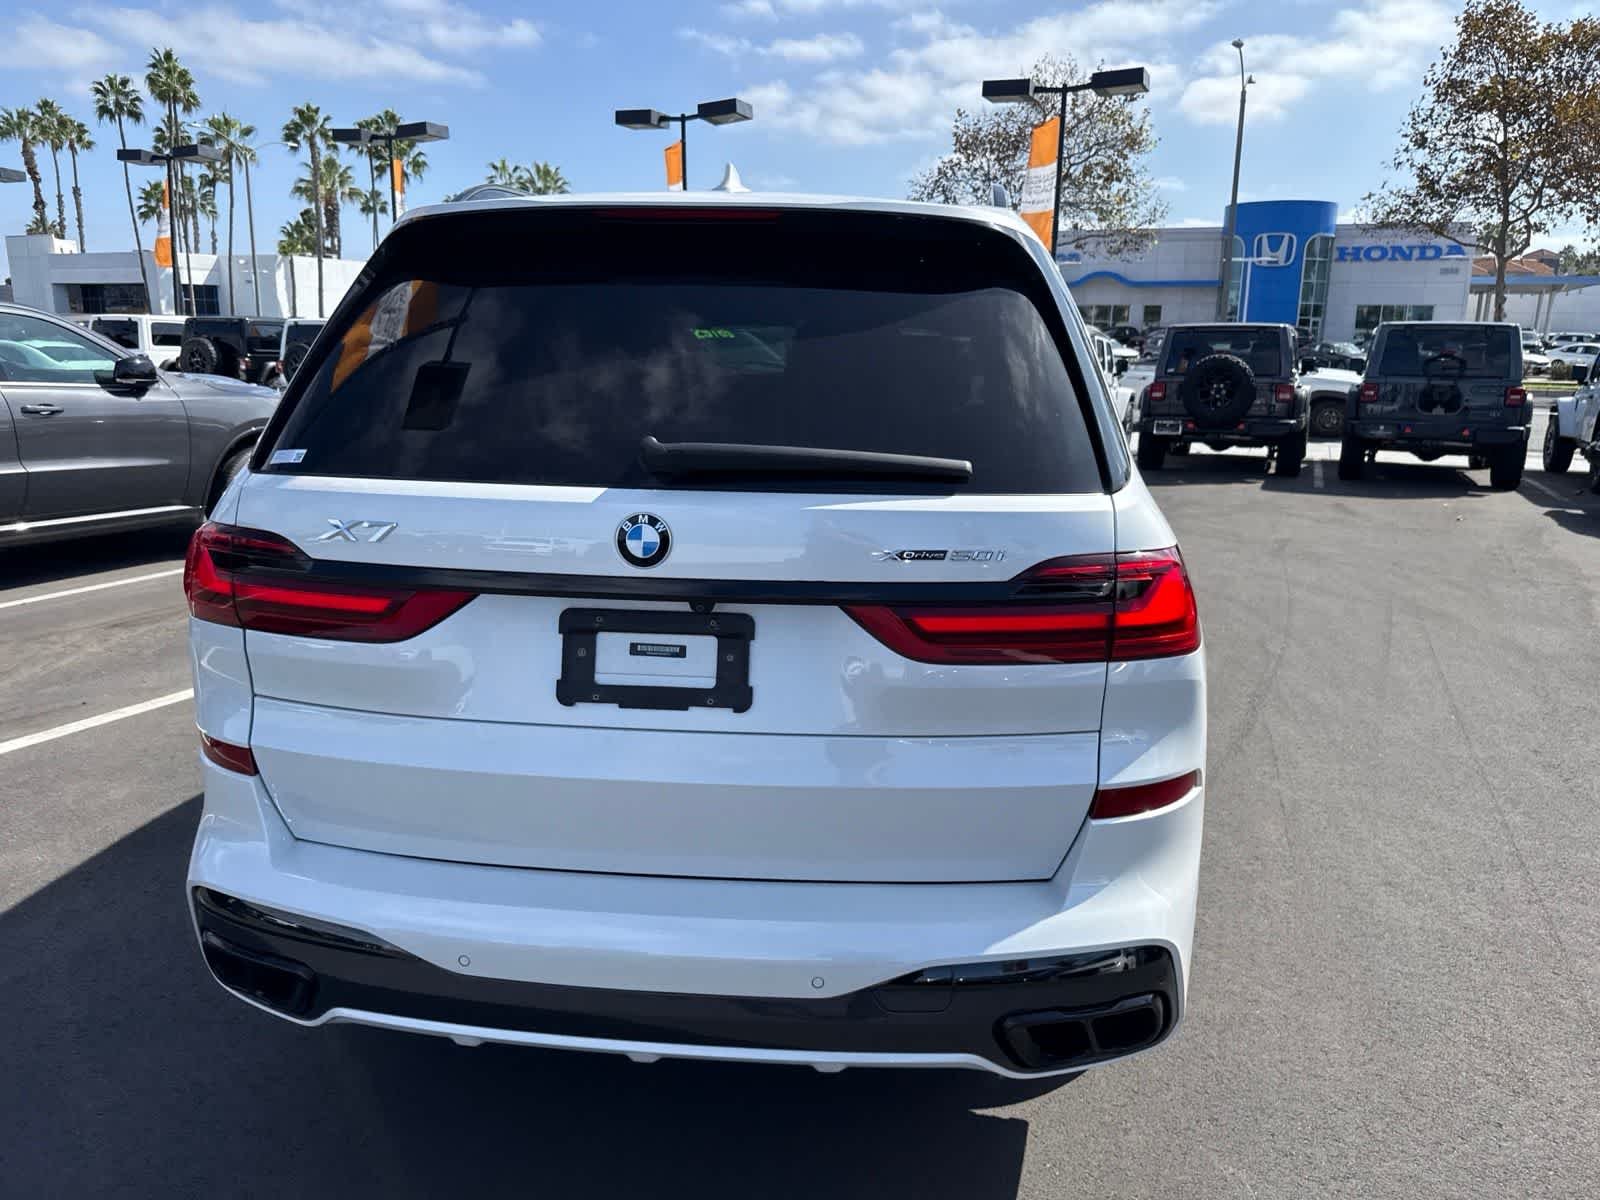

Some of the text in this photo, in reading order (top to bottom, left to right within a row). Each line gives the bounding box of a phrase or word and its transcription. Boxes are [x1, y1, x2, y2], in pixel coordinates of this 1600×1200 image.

[1335, 244, 1465, 262] HONDA
[314, 518, 398, 543] X7
[622, 514, 667, 533] BMW
